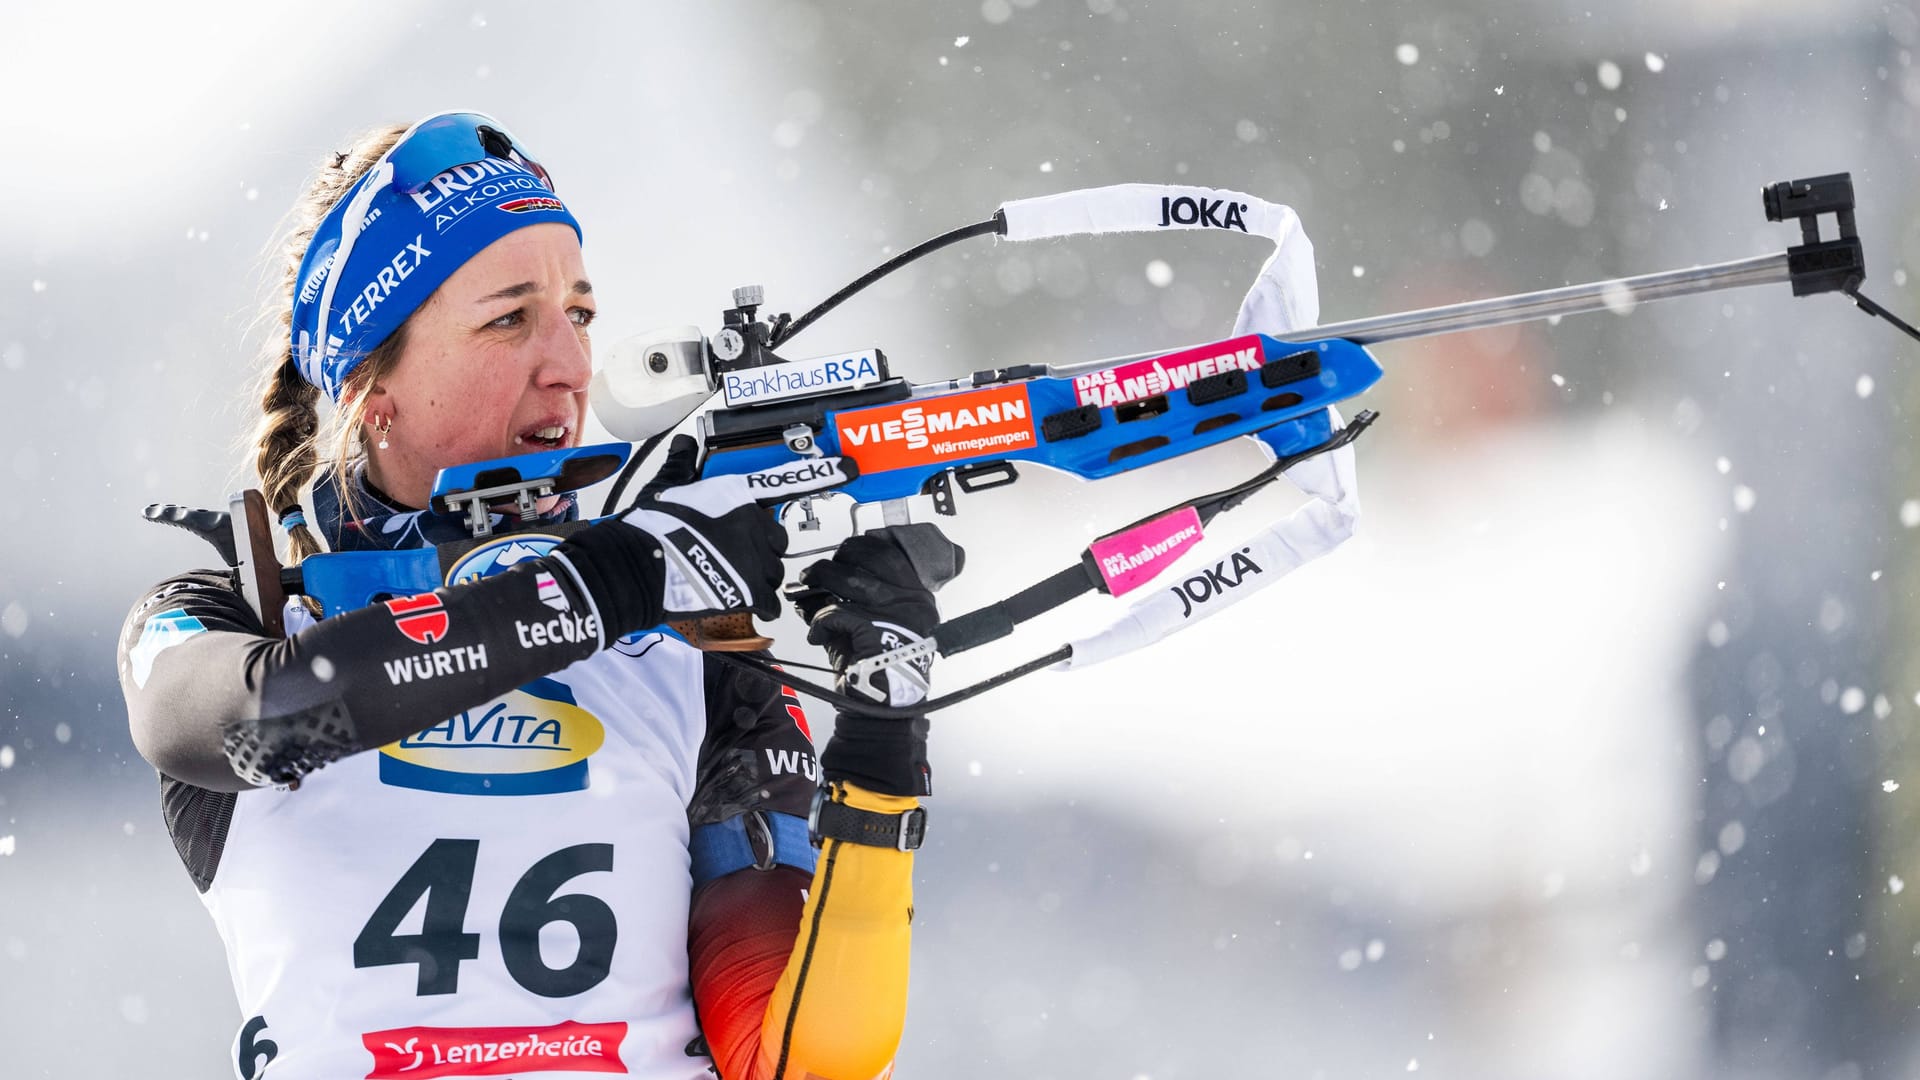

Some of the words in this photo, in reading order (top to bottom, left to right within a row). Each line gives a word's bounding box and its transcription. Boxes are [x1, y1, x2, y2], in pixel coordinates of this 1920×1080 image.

[410, 157, 526, 213] ERDIN
[339, 234, 432, 335] TERREX
[727, 357, 877, 400] BankhausRSA
[1076, 369, 1117, 391] DAS
[842, 400, 1027, 450] VIESSMANN
[931, 430, 1030, 456] Wärmepumpen
[1102, 552, 1126, 567] DAS
[514, 610, 597, 649] tecbke
[384, 644, 489, 686] WÜRTH
[353, 838, 618, 998] 46
[433, 1033, 603, 1065] Lenzerheide
